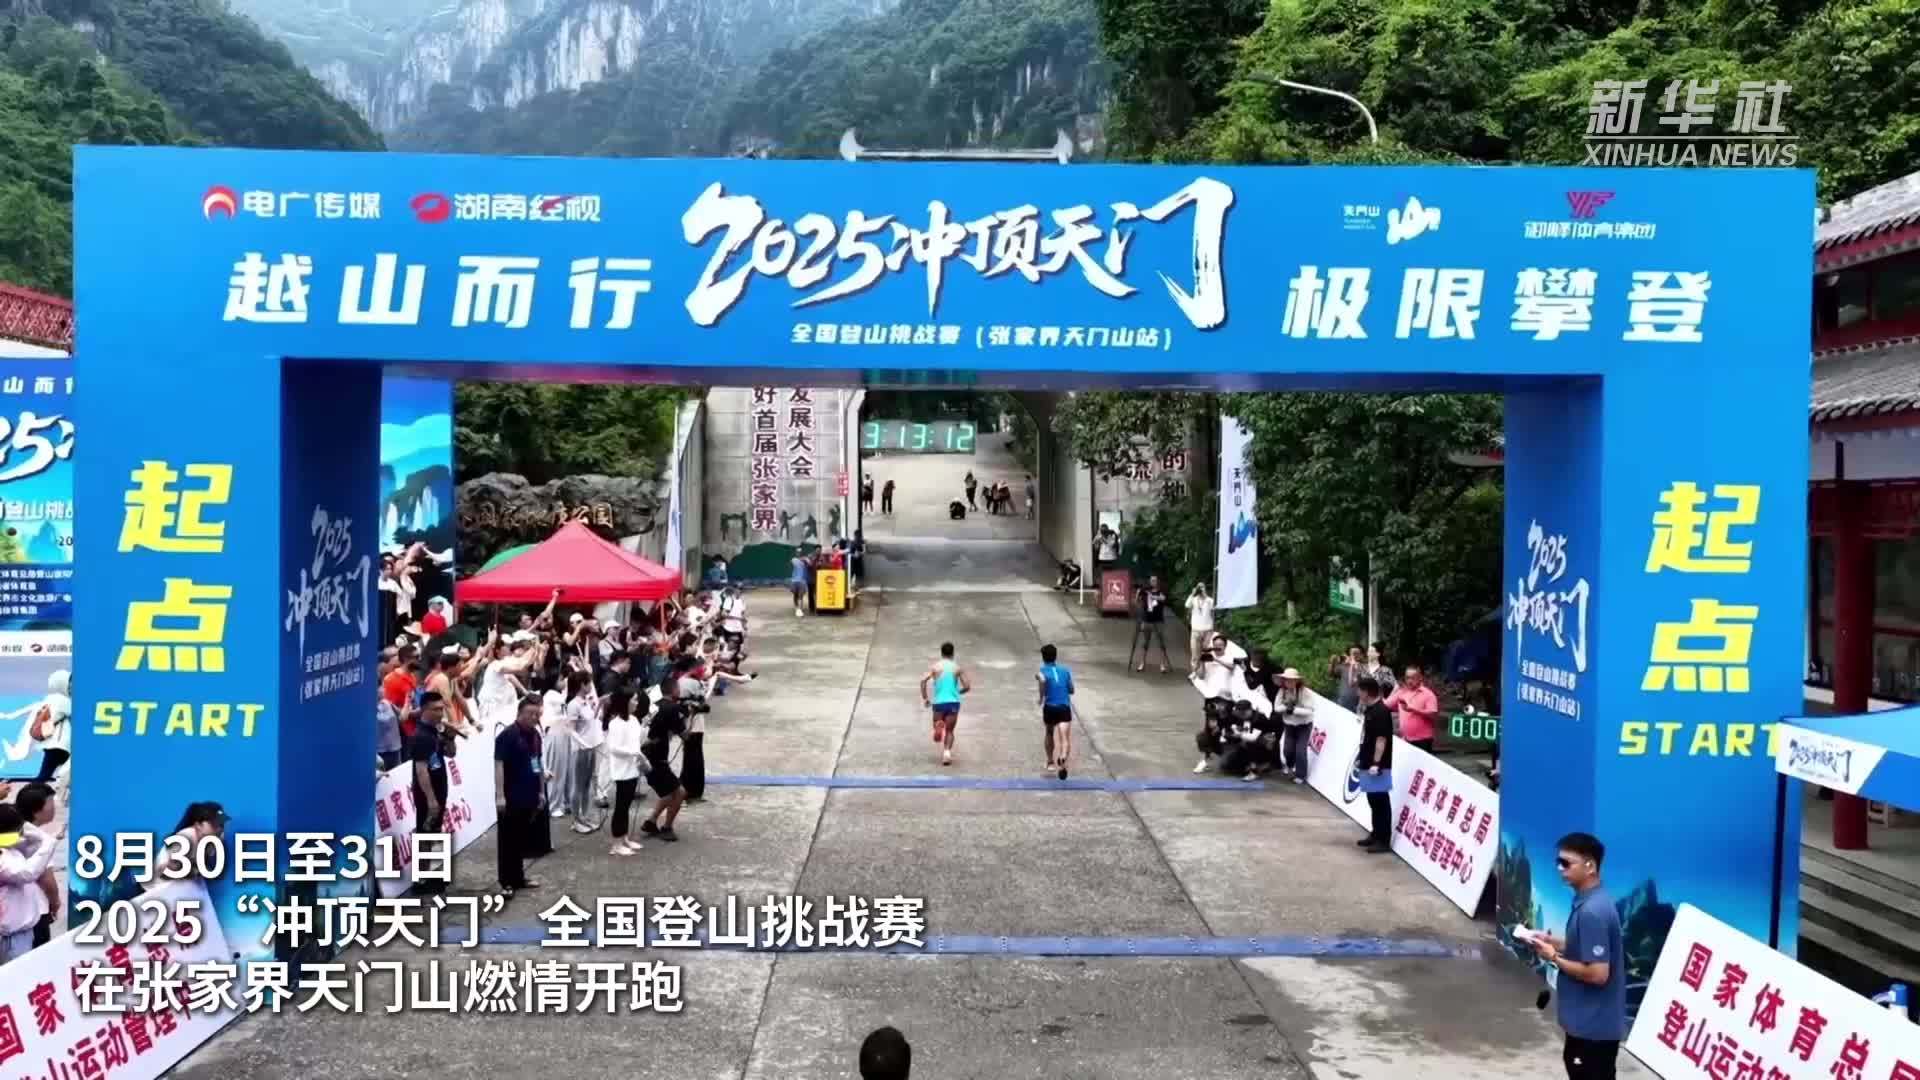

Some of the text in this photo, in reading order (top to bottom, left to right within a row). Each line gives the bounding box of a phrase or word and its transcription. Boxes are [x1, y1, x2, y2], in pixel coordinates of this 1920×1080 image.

[242, 190, 382, 219] 电广传媒
[453, 193, 602, 223] 湖南经视
[222, 250, 653, 331] 越山而行
[1280, 264, 1713, 344] 极限攀登
[115, 460, 233, 673] 起点
[311, 504, 352, 581] 2025
[1527, 518, 1568, 593] 2025
[284, 554, 372, 667] 冲顶天门
[1506, 577, 1590, 673] 冲顶天门
[1640, 480, 1761, 693] 起点
[92, 701, 265, 738] START
[1408, 768, 1493, 845] 国家体育总局
